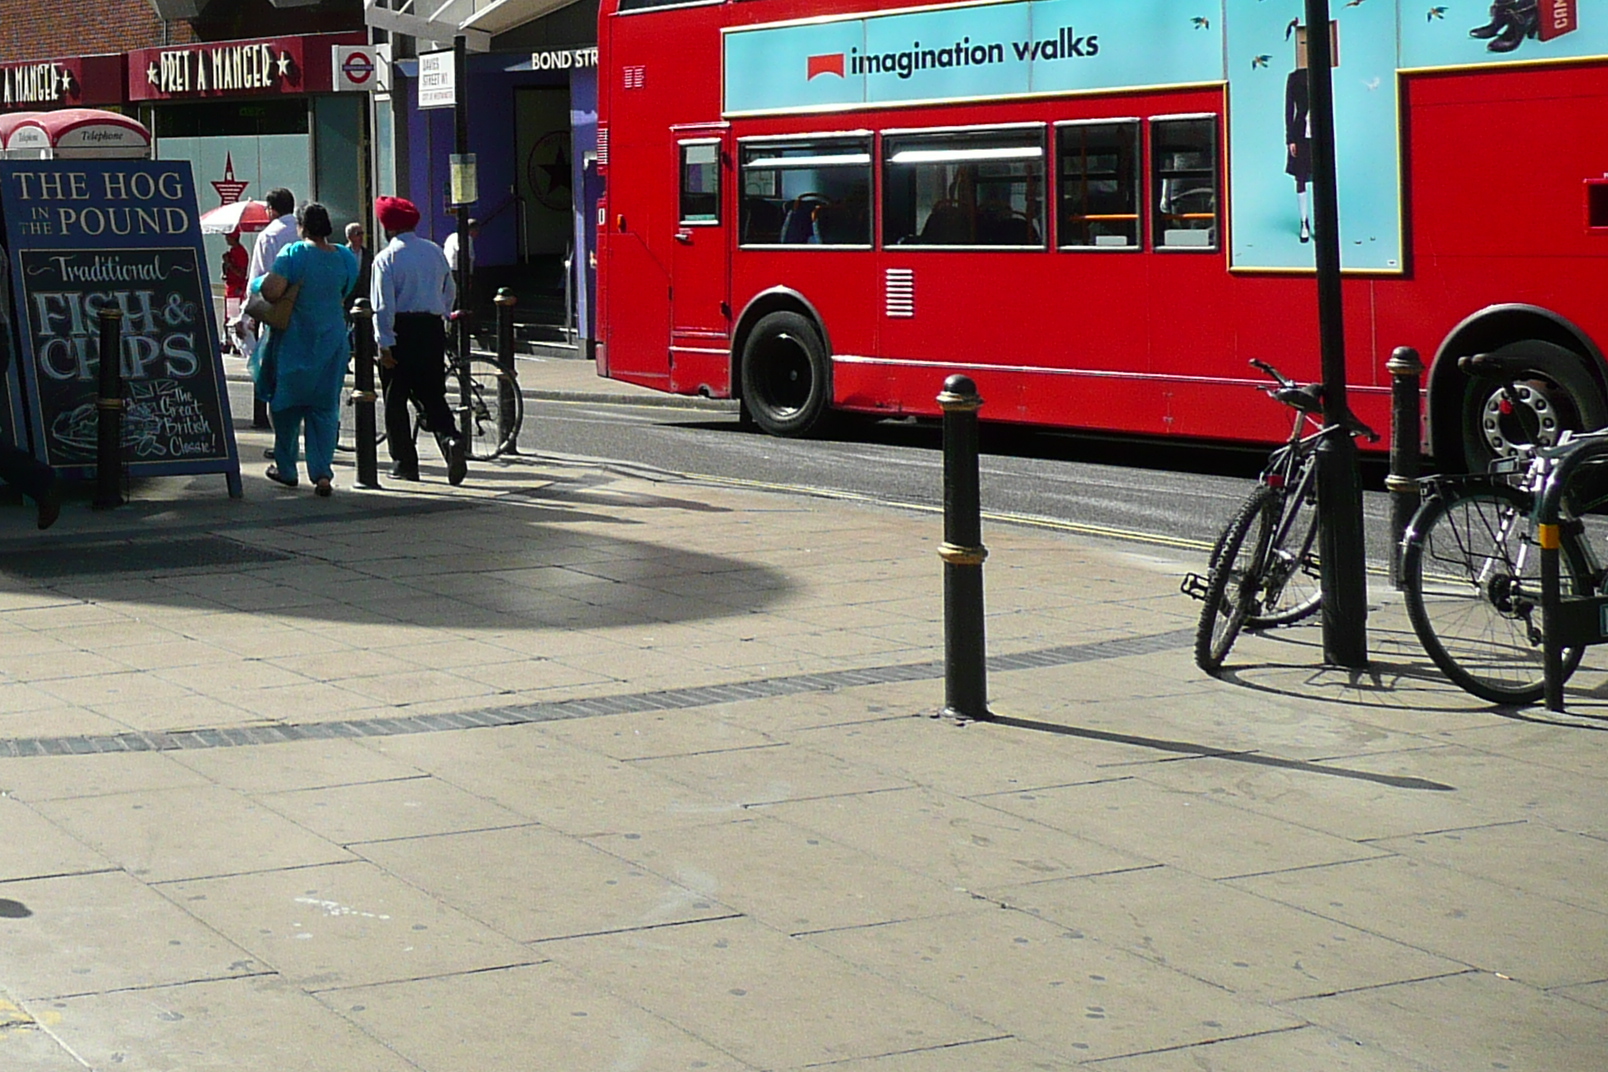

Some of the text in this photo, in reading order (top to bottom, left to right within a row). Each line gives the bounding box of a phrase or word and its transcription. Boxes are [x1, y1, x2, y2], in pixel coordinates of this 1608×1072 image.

[532, 50, 573, 70] BOND
[851, 26, 1100, 79] imagination walks
[161, 43, 273, 92] PRET A MANGER
[4, 66, 11, 103] A
[15, 63, 63, 102] MANGER
[81, 130, 124, 144] Telephone
[12, 172, 90, 200] THE
[101, 172, 184, 200] HOG
[19, 207, 189, 236] THE POUND
[31, 206, 49, 220] IN
[49, 254, 170, 282] Traditional
[162, 291, 198, 326] &
[160, 395, 203, 418] Great
